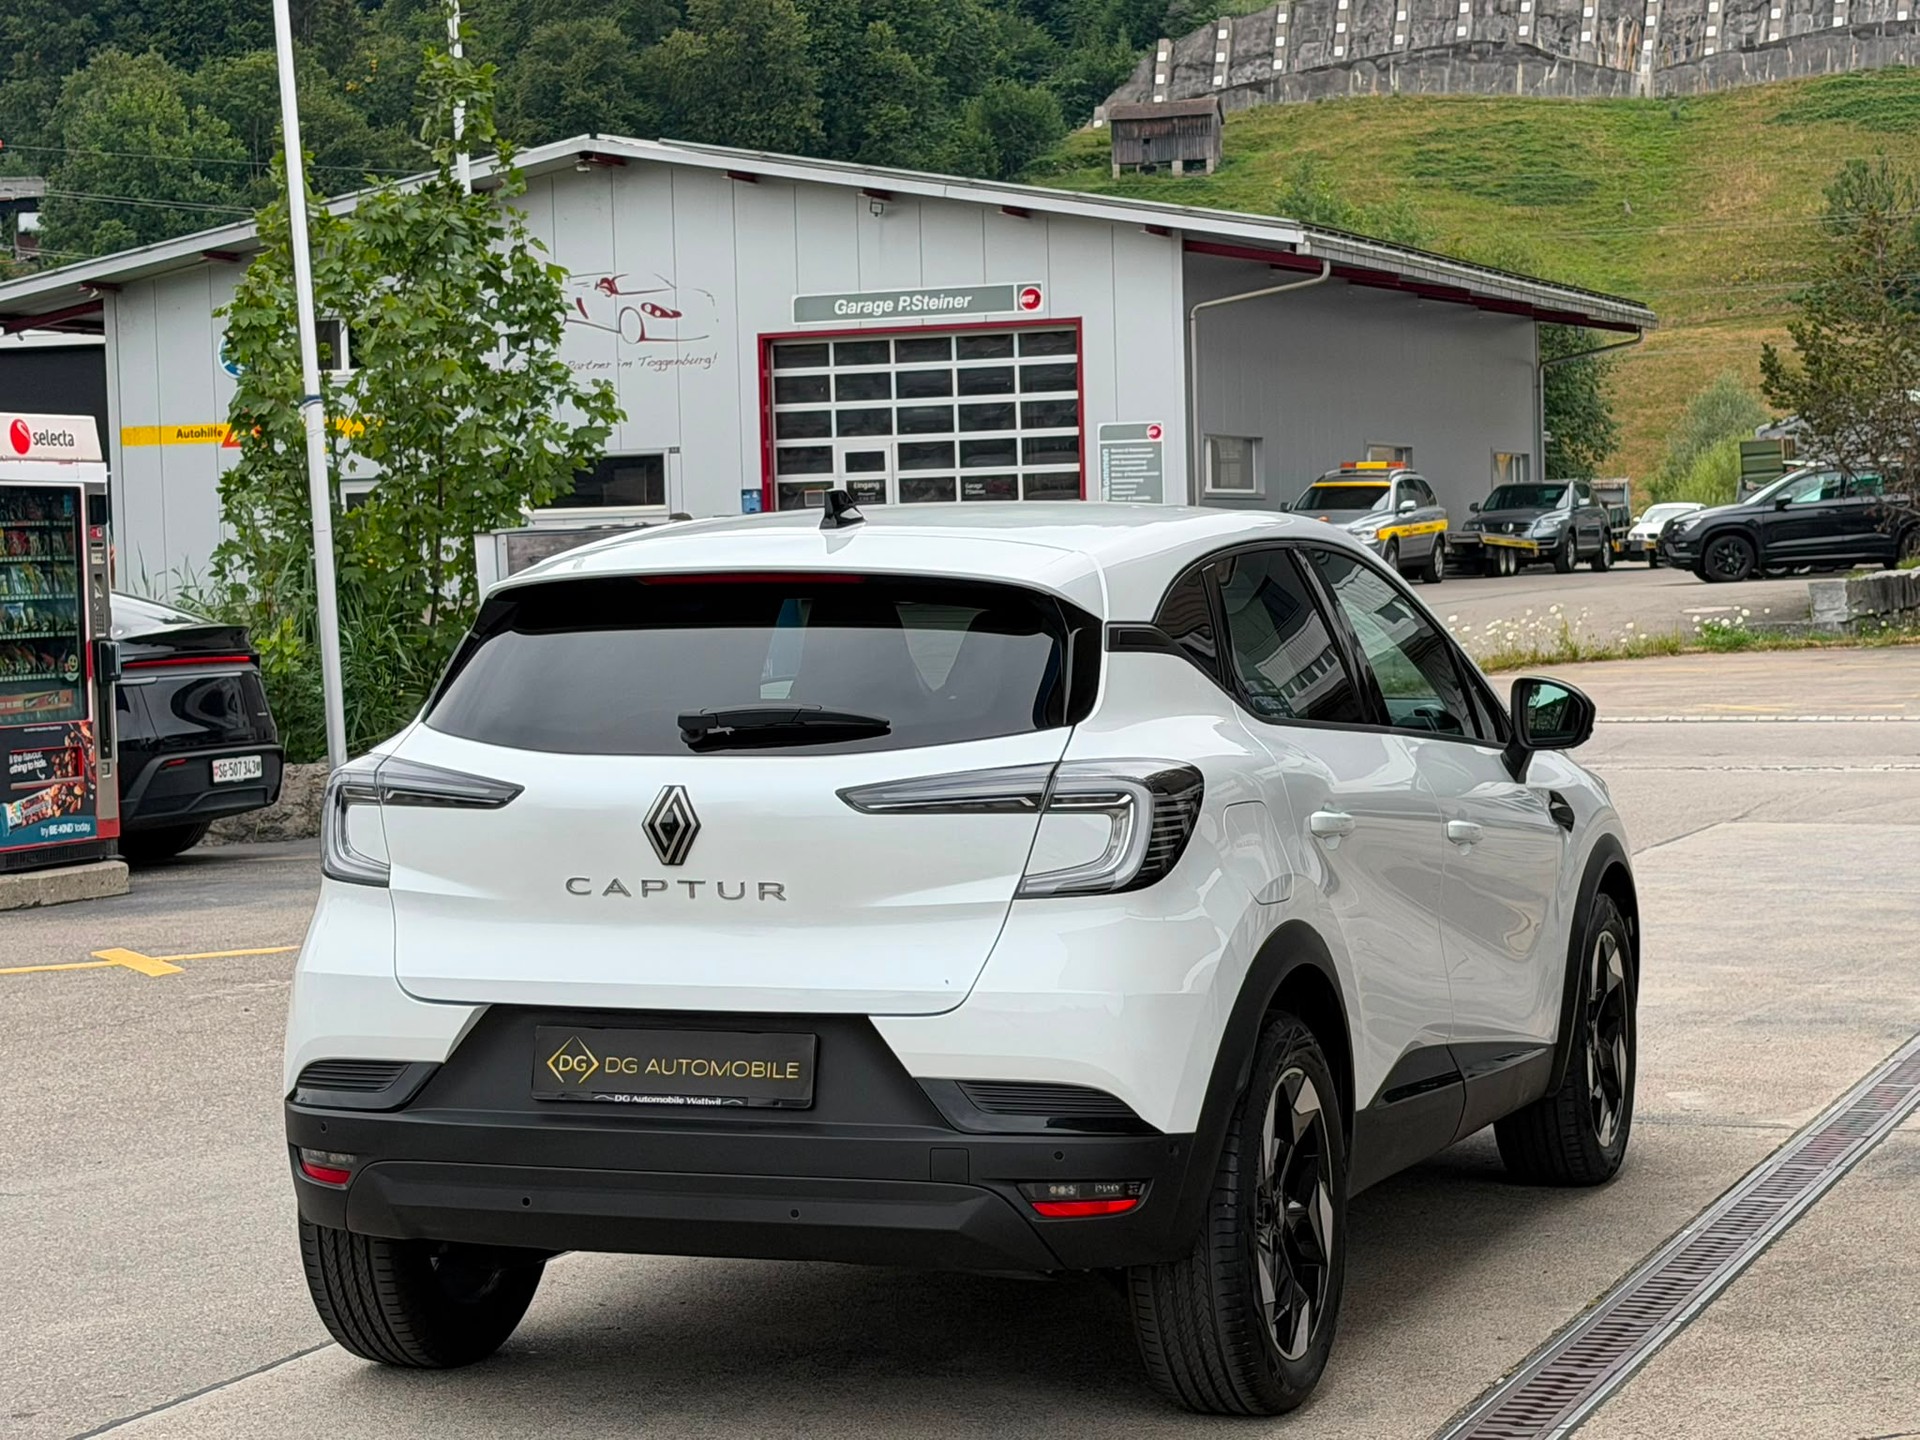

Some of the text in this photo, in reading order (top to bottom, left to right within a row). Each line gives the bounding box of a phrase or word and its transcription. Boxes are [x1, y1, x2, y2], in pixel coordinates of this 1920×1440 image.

[834, 299, 894, 316] Garage
[617, 358, 632, 369] im
[638, 351, 717, 372] Toggenburg!
[32, 429, 75, 447] selecta
[176, 427, 223, 440] Autohilfe
[565, 877, 787, 900] CAPTUR
[558, 1055, 587, 1072] DG
[604, 1057, 800, 1079] DG AUTOMOBILE
[614, 1094, 722, 1105] DG Automobile Wattwil
